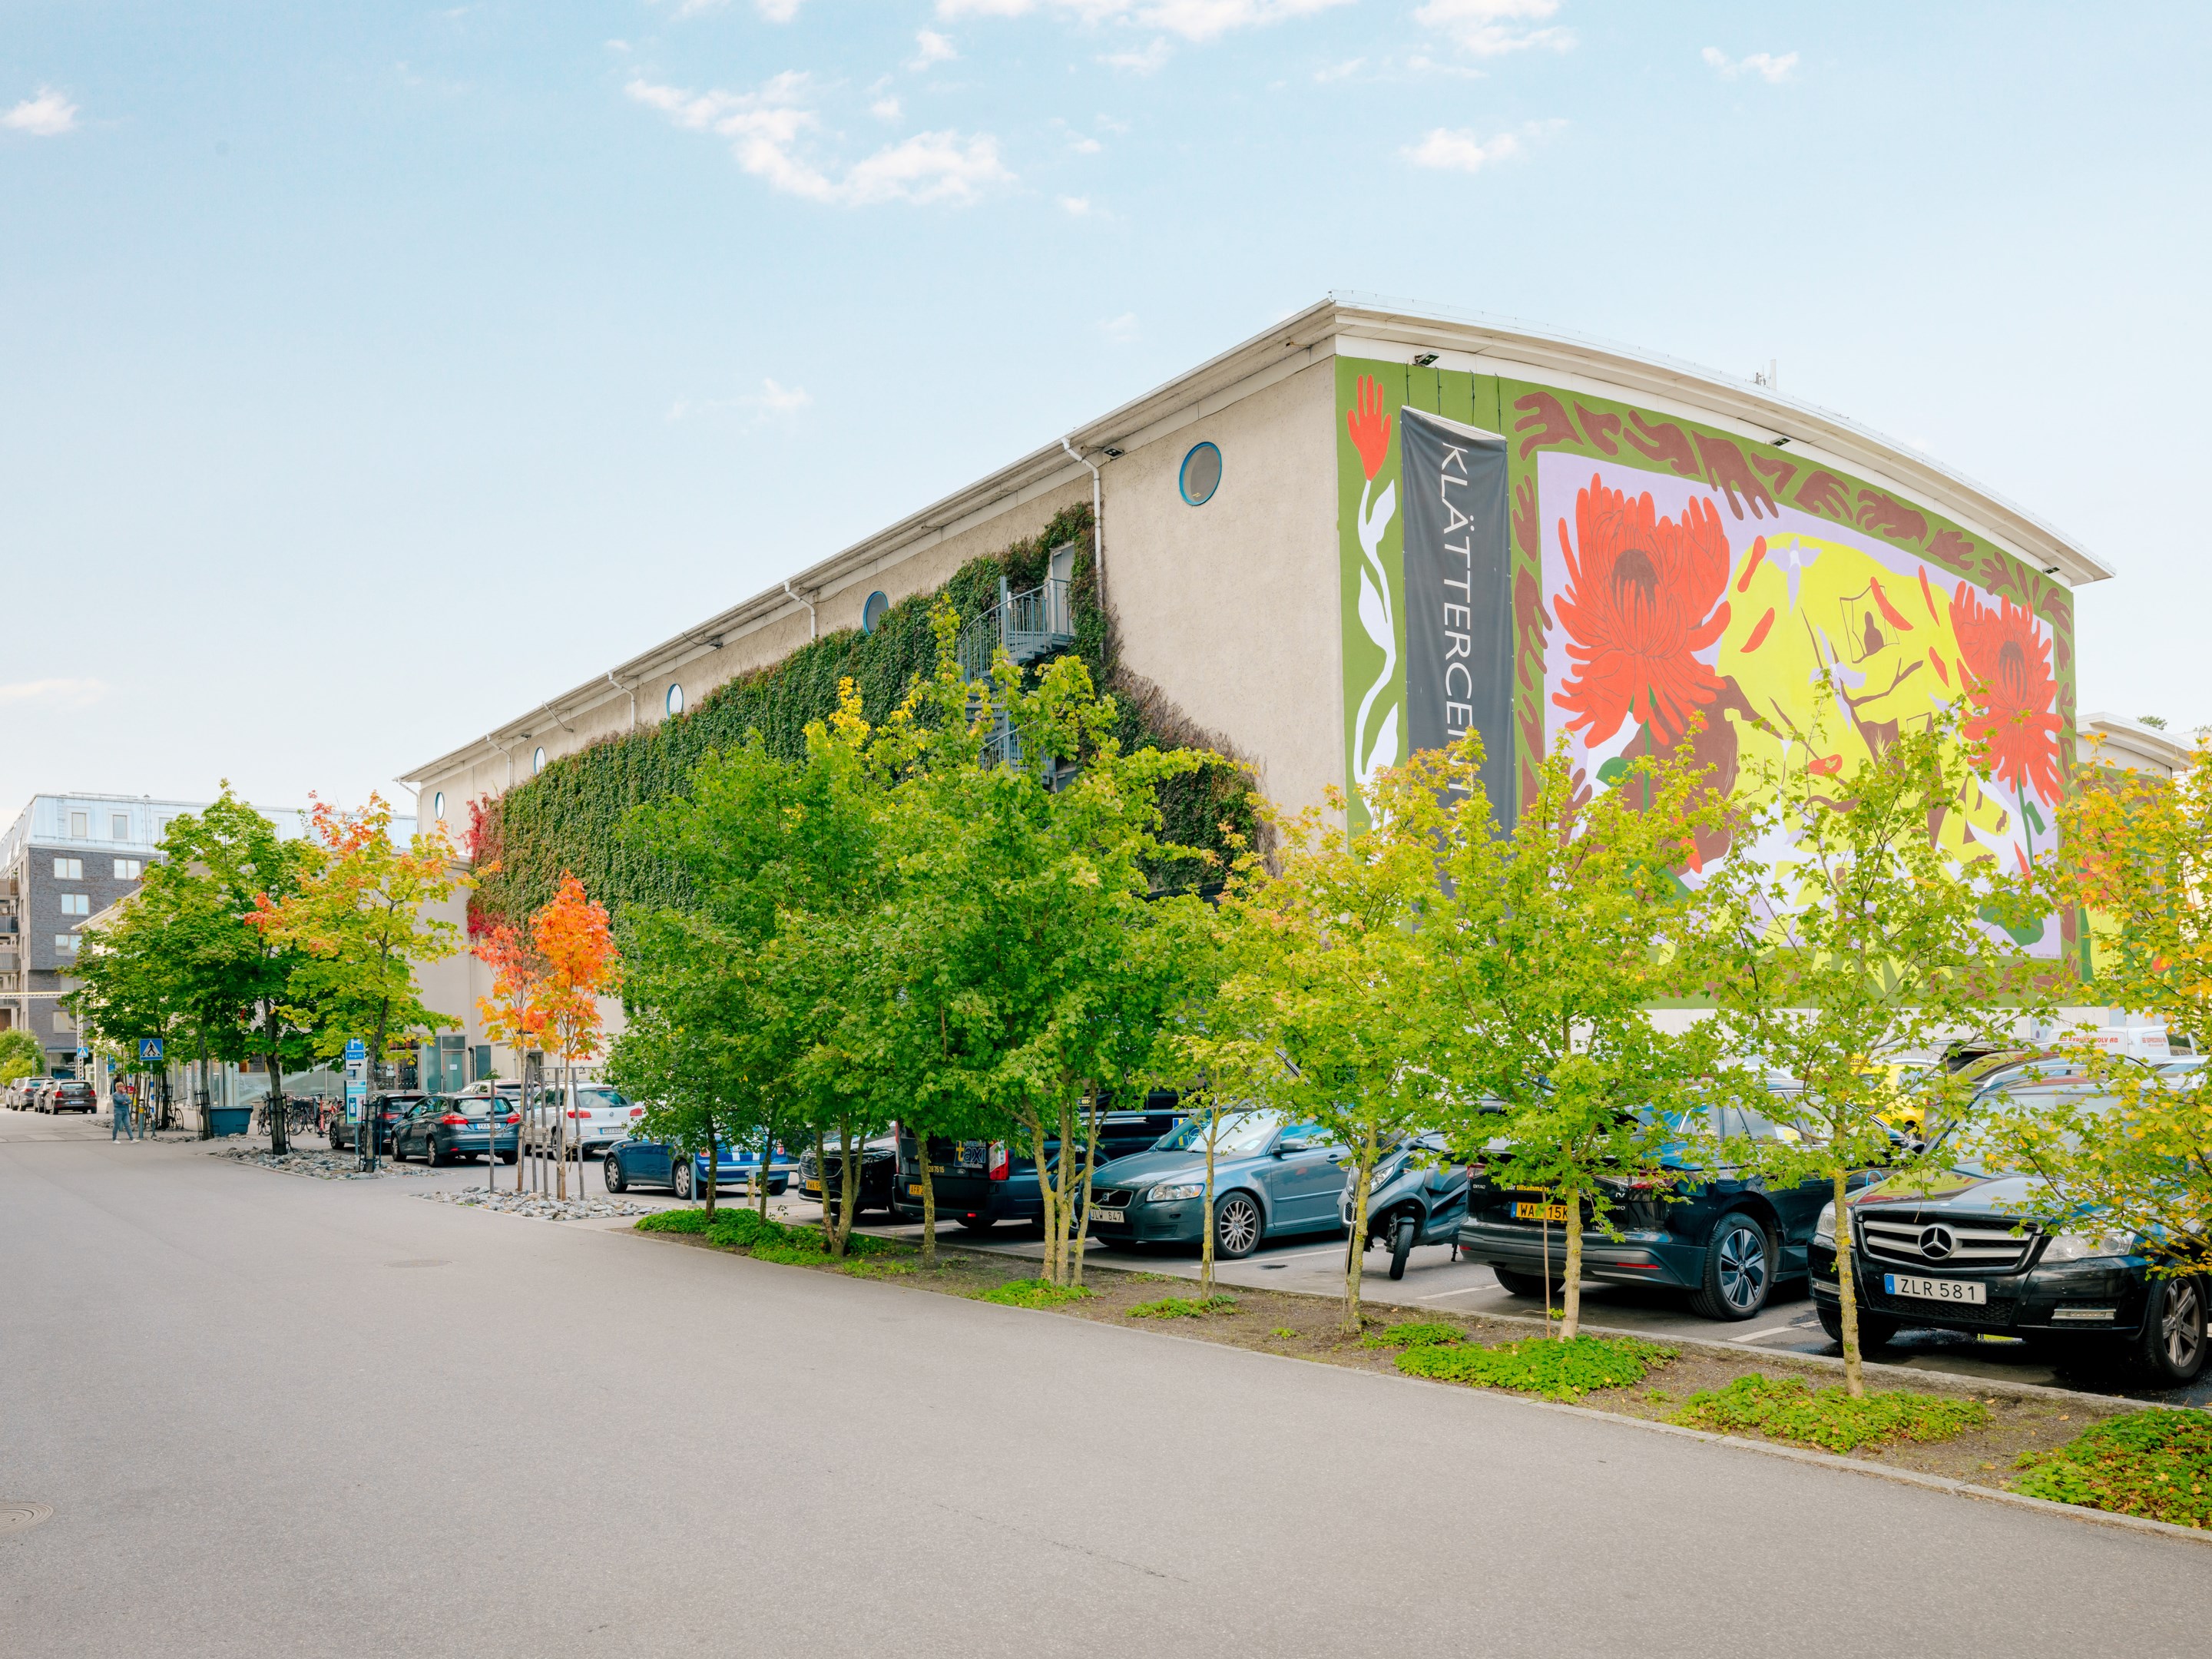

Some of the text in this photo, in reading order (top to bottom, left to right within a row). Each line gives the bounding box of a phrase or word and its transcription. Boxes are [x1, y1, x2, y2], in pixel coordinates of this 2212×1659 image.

[1108, 1211, 1121, 1221] 647
[1900, 1278, 1975, 1301] ZLR 581
